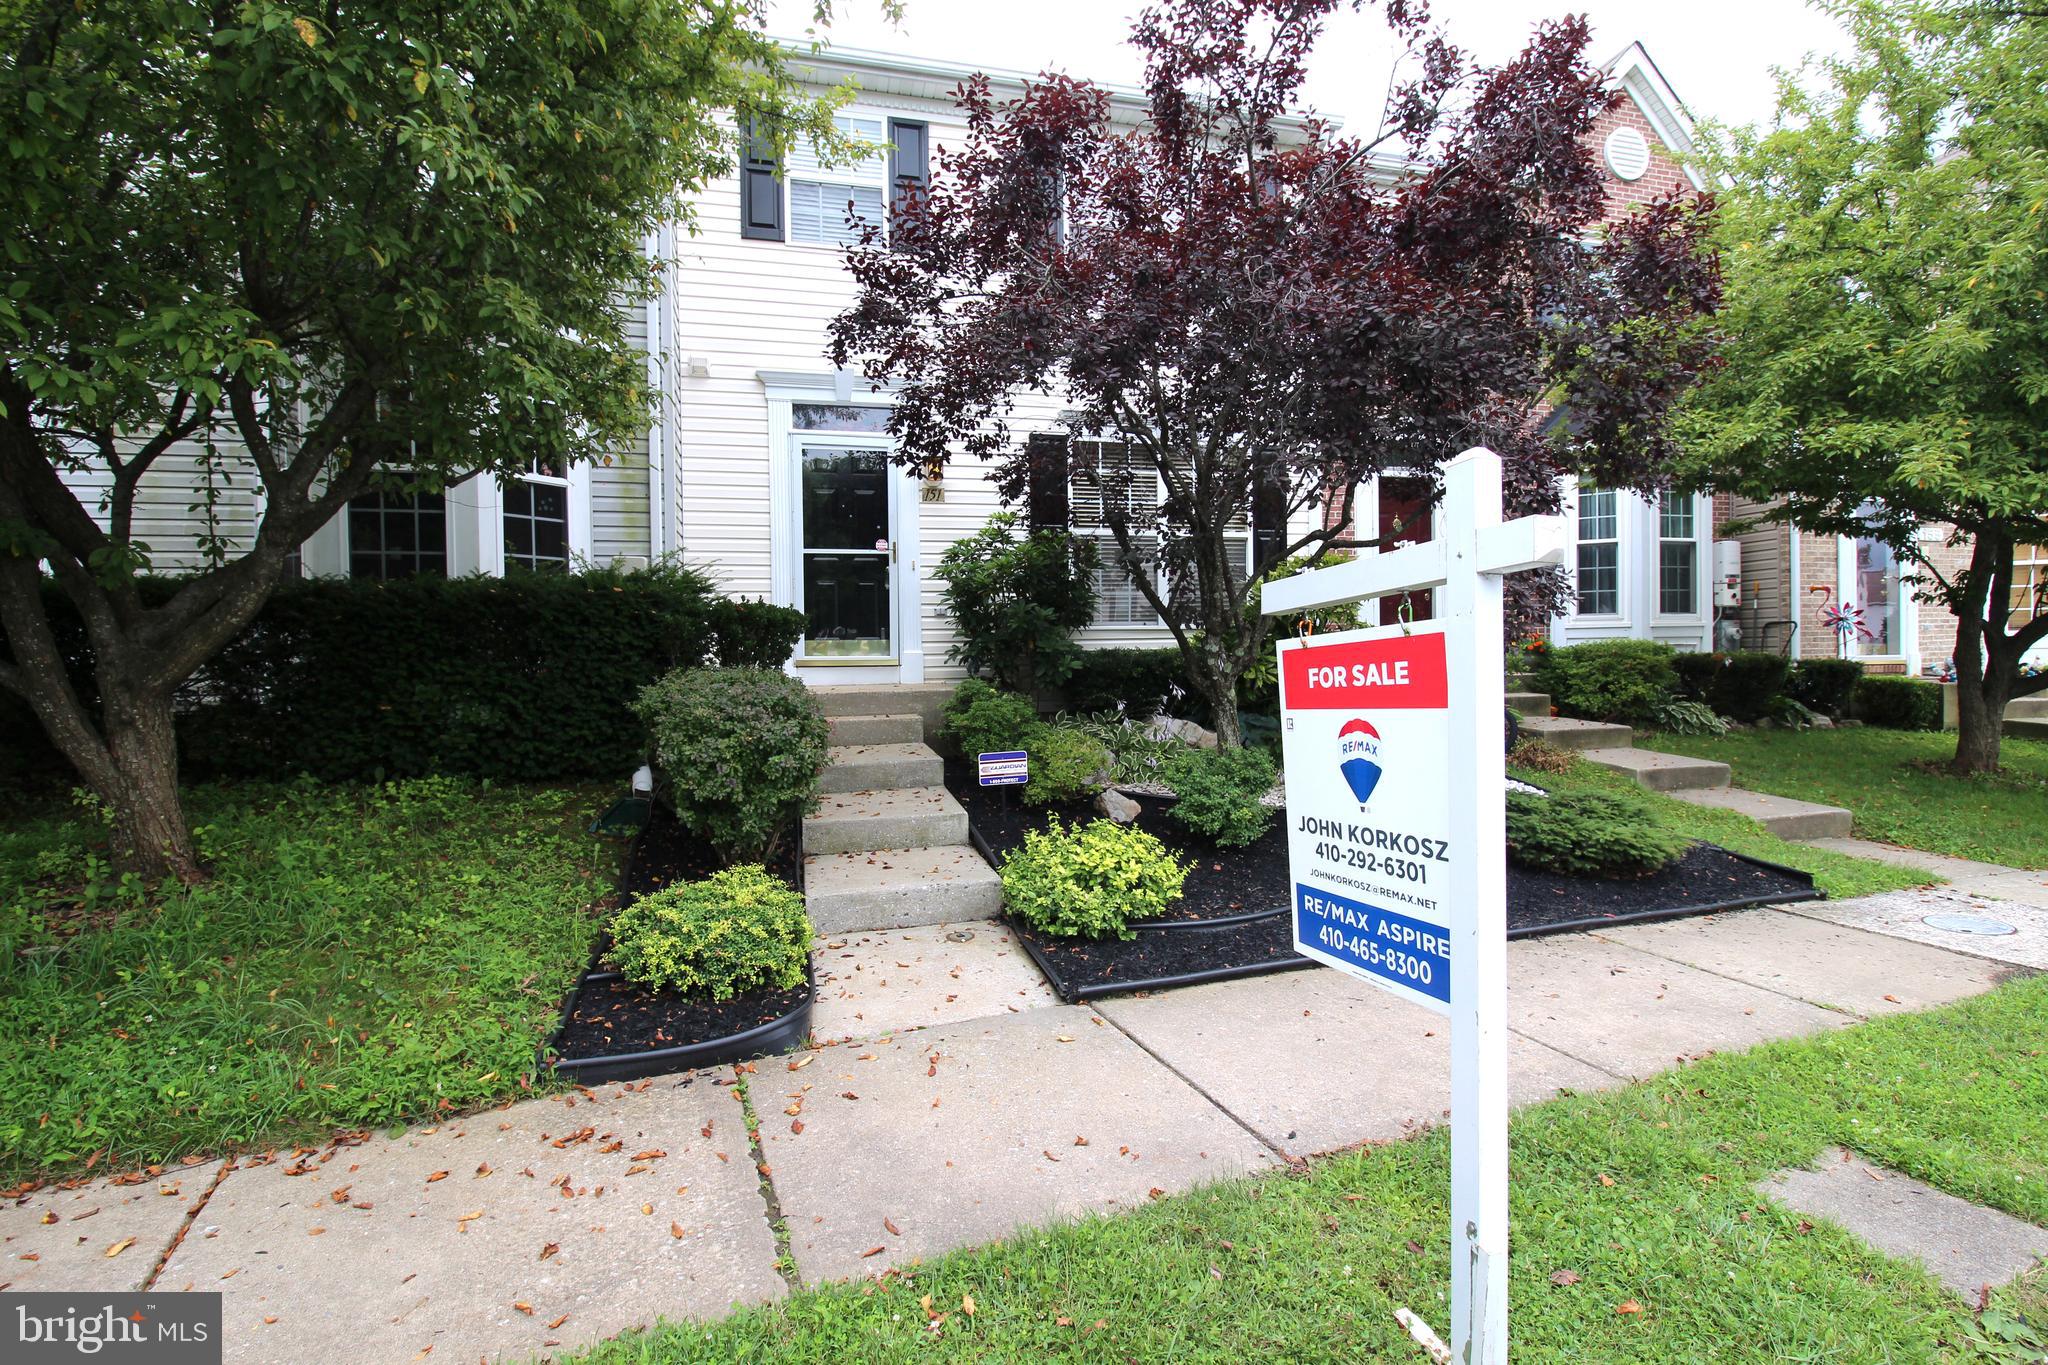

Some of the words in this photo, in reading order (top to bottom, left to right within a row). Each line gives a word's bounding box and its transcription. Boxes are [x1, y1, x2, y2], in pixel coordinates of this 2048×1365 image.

[924, 488, 942, 501] 151
[1308, 666, 1347, 689] FOR
[1352, 661, 1410, 687] SALE
[1342, 740, 1378, 757] RE/MAX
[1299, 815, 1343, 840] JOHN
[1348, 824, 1450, 862] KORKOSZ
[1315, 841, 1427, 884] 410-292-6301
[1310, 868, 1438, 911] JOHNKORKOSZ@REMAX.NET
[1304, 894, 1370, 932] RE/MAX
[1377, 919, 1450, 960] ASPIRE
[1319, 924, 1433, 985] 410-465-8300
